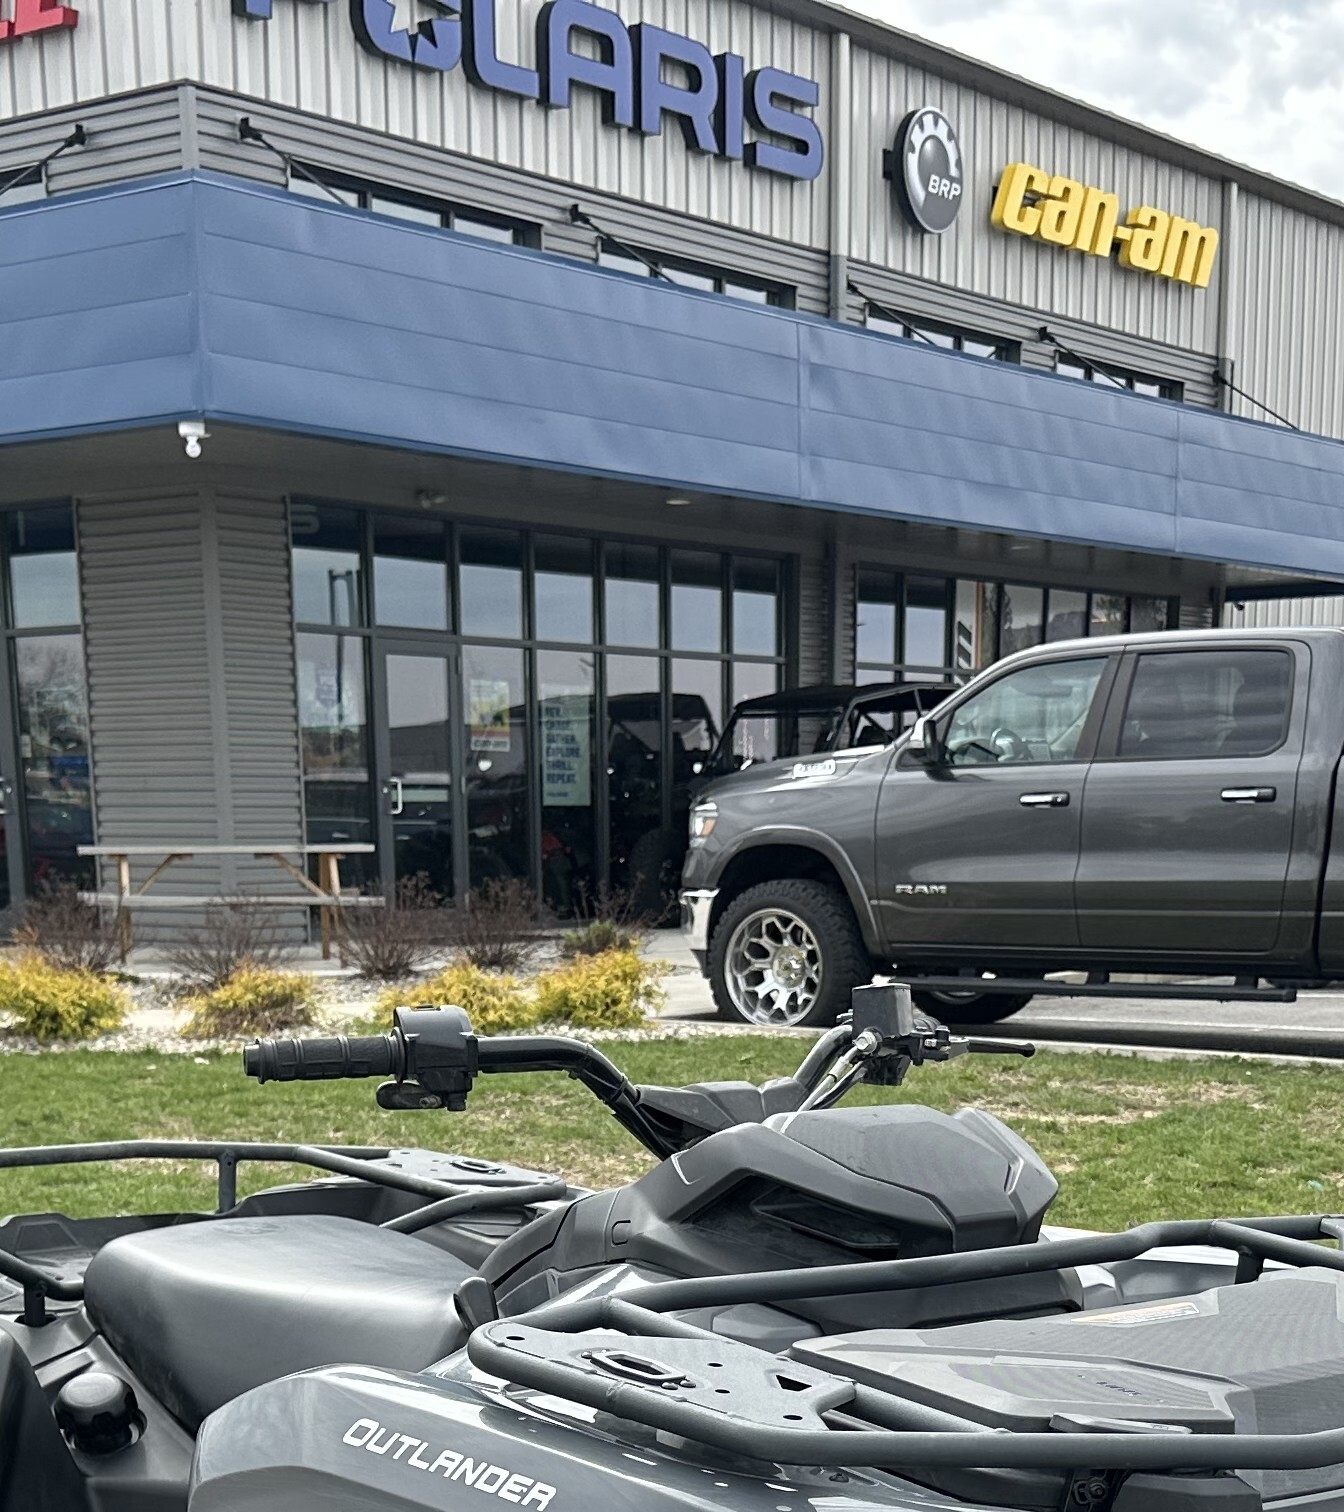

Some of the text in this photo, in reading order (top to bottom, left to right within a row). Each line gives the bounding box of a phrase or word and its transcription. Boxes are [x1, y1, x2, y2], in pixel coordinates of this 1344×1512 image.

[233, 0, 824, 181] OLARIS
[927, 173, 961, 200] BRP
[991, 162, 1220, 289] can-am
[895, 883, 947, 895] RAM
[342, 1417, 557, 1512] OUTLANDER
